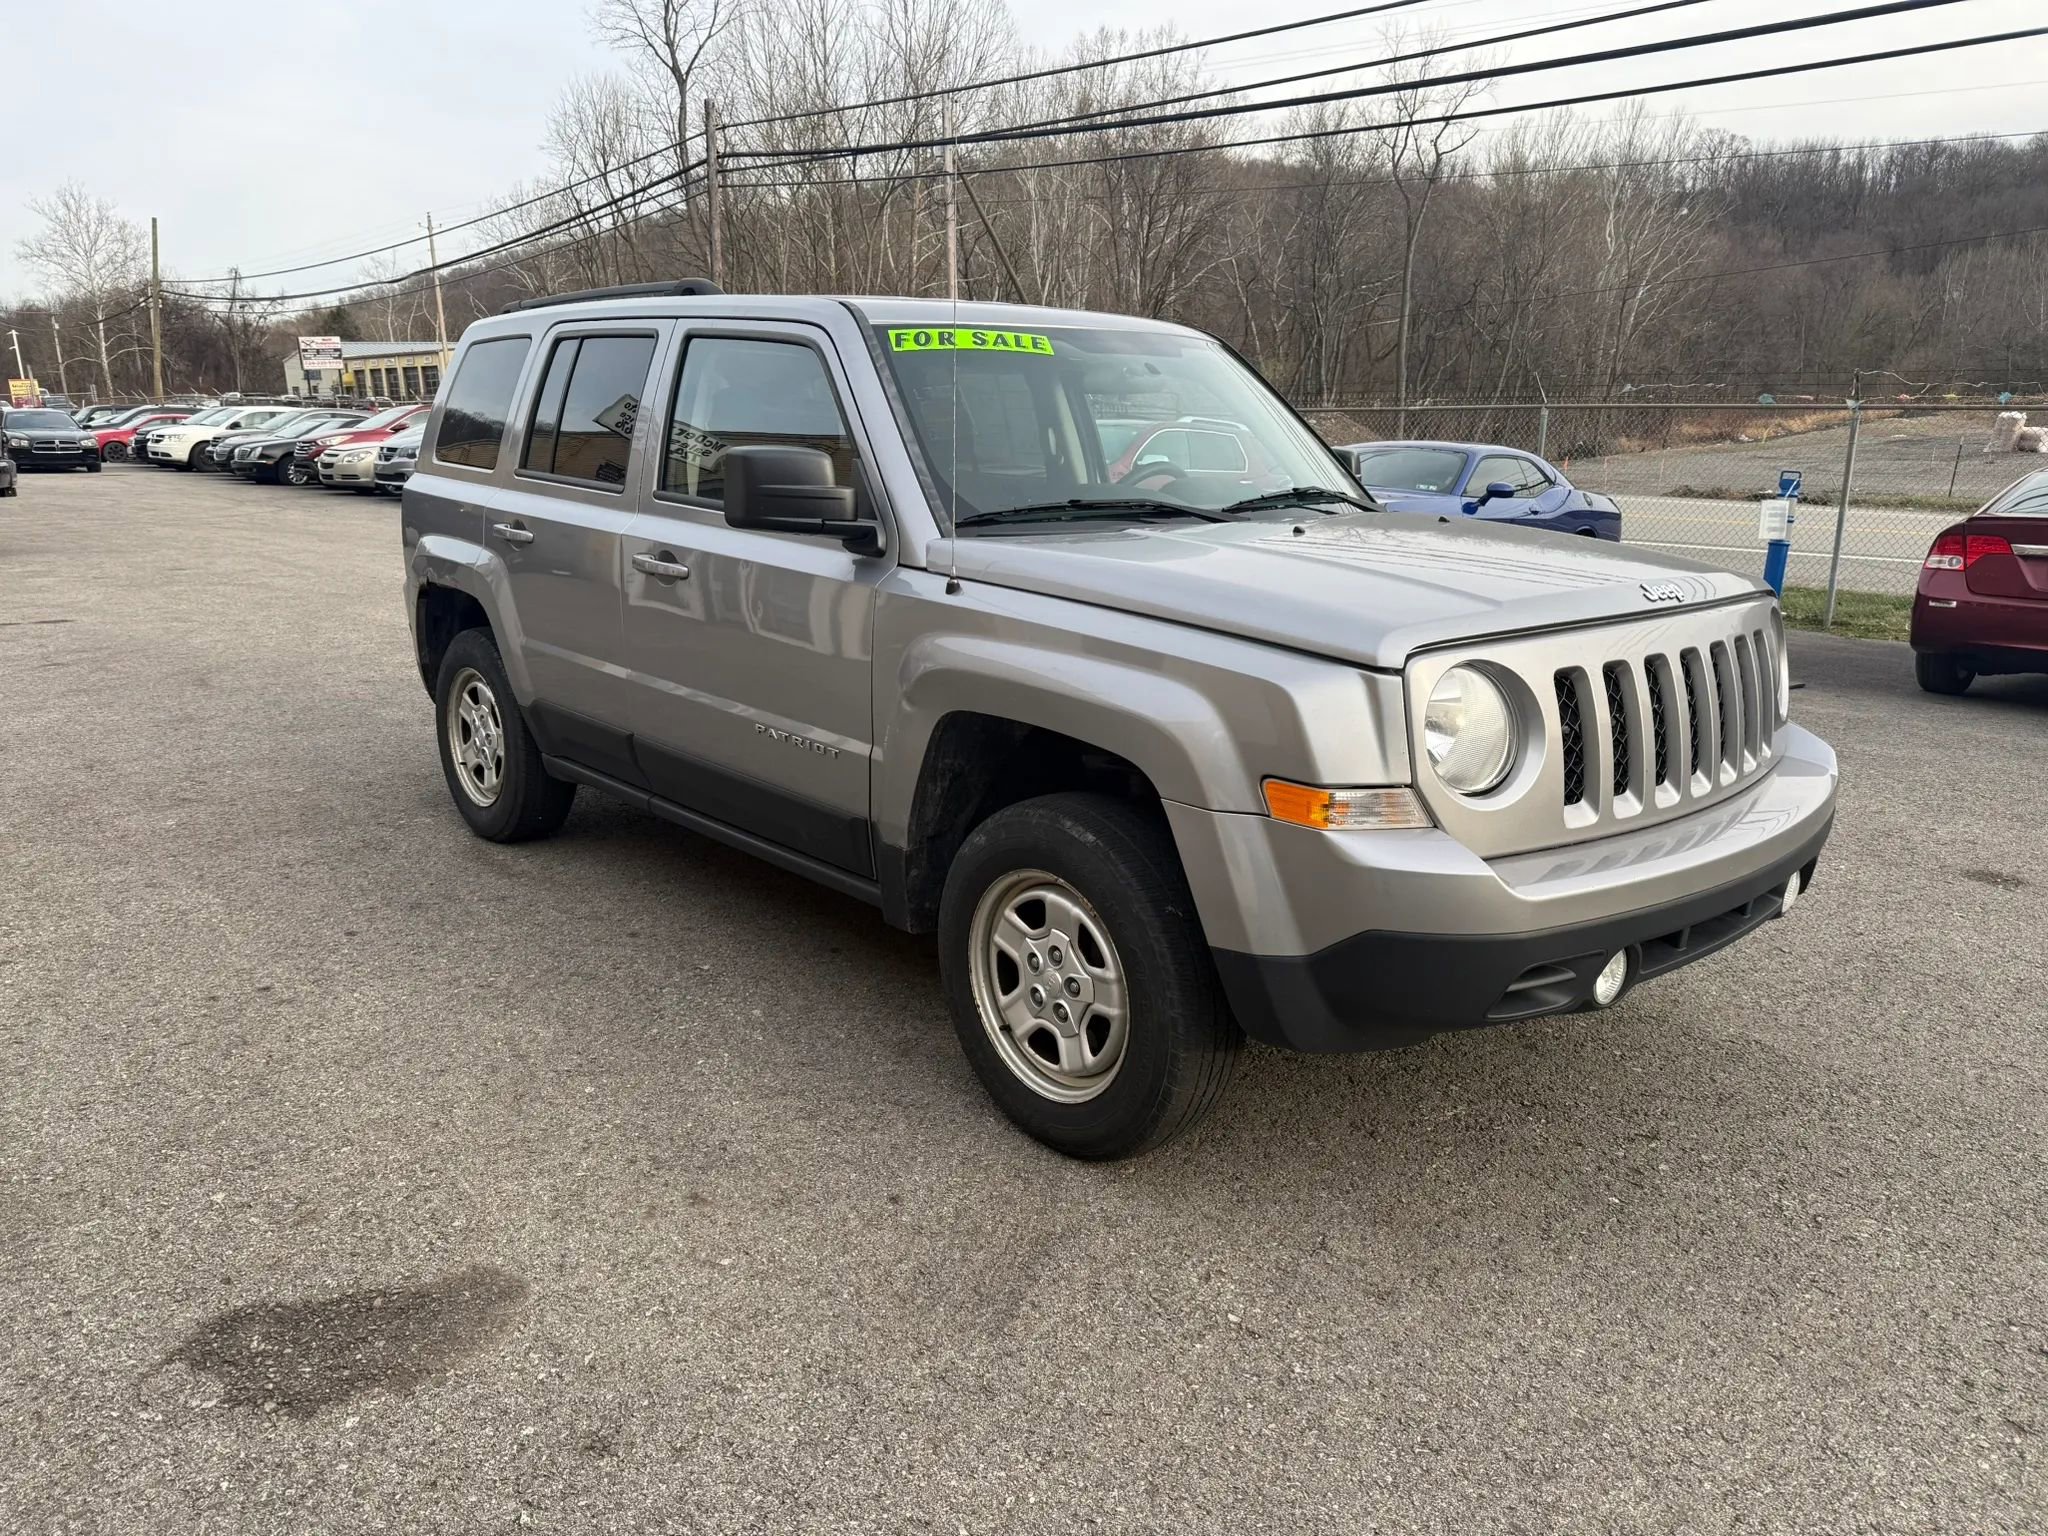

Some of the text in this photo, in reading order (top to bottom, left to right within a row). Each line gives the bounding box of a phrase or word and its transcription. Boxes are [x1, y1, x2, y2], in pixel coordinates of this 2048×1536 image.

[895, 331, 1047, 351] FOR SALE
[1639, 584, 1686, 602] Jeep
[755, 723, 840, 759] PATRIOT
